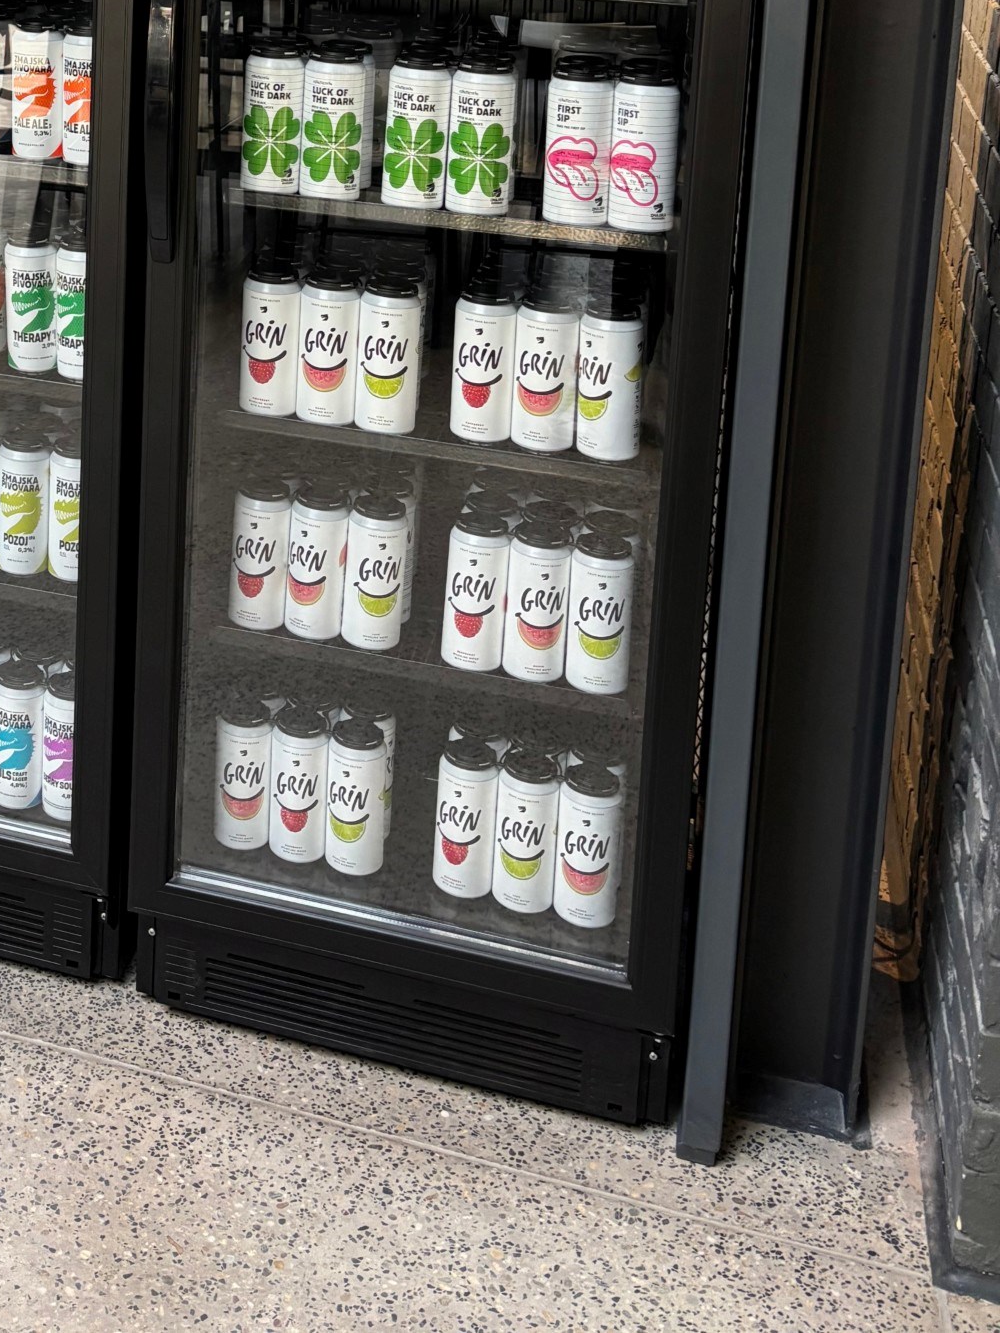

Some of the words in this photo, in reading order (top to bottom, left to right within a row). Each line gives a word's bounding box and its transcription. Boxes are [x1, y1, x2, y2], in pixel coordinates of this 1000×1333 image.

[14, 55, 50, 65] ZMAJSKA
[14, 64, 52, 73] PIVOVARA
[250, 80, 270, 91] LUCK
[312, 86, 333, 96] LUCK
[251, 89, 264, 98] THE
[267, 92, 291, 100] DARK
[394, 91, 414, 102] LUCK
[417, 94, 430, 103] OF
[312, 95, 327, 104] THE
[330, 97, 354, 106] DARK
[394, 100, 408, 110] THE
[410, 103, 435, 112] DARK
[458, 96, 479, 106] LUCK
[483, 99, 496, 107] OF
[458, 105, 473, 115] THE
[476, 108, 502, 116] DARK
[558, 104, 582, 115] FIRST
[618, 108, 639, 118] FIRST
[14, 116, 30, 129] PALE
[32, 119, 49, 129] ALE
[557, 113, 570, 122] SIP
[617, 117, 628, 125] SIP
[12, 272, 51, 280] ZMAJSKA
[12, 279, 54, 288] PIVOVARA
[13, 330, 51, 342] THERAPY
[2, 472, 39, 484] ZMAJSKA
[2, 480, 40, 492] PIVOVARA
[3, 533, 28, 546] POZOJ
